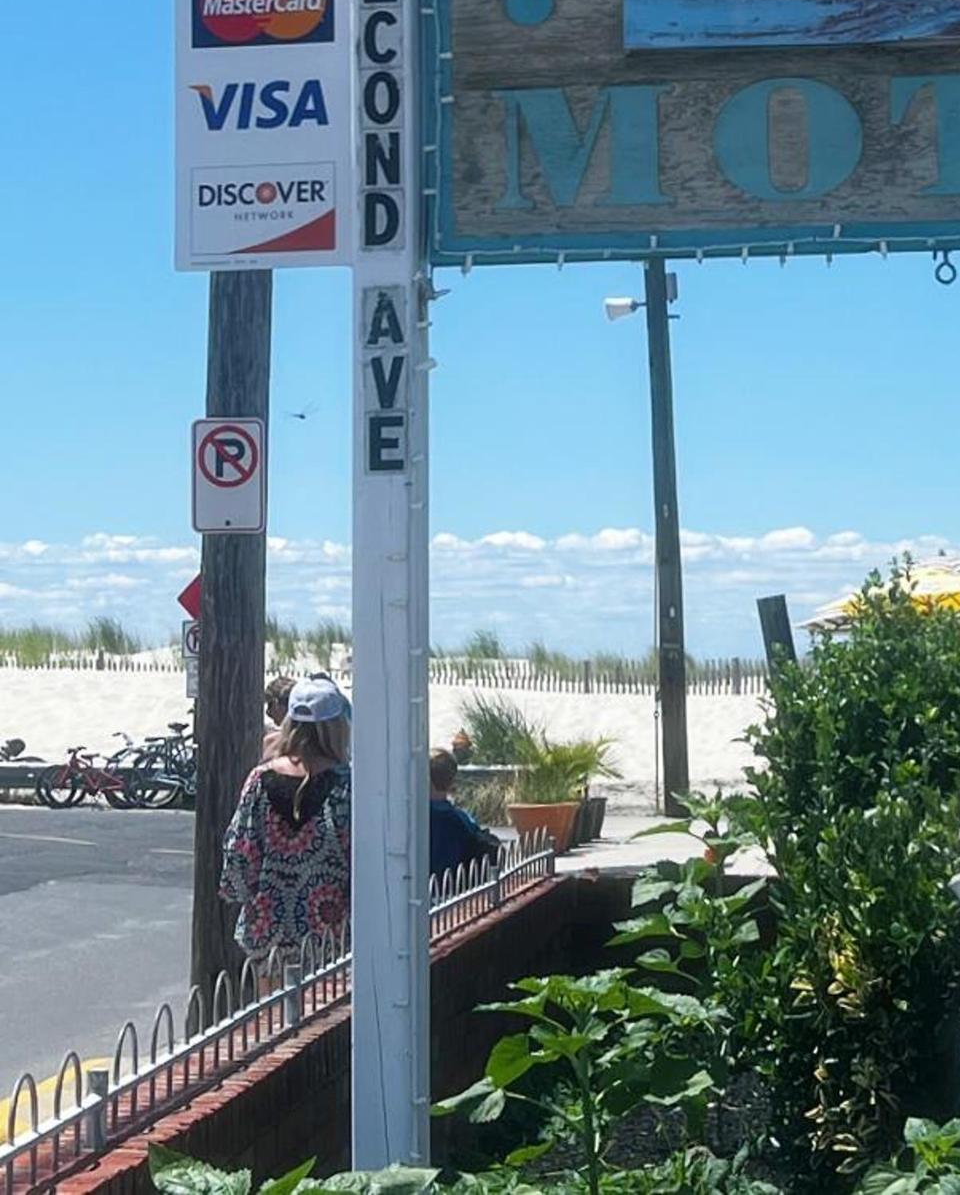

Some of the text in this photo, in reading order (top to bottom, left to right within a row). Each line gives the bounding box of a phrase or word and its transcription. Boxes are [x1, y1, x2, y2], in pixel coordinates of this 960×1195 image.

[188, 79, 329, 131] VISA
[198, 180, 326, 207] DISCOVER
[234, 210, 294, 222] NETWORK
[366, 290, 405, 472] AVE
